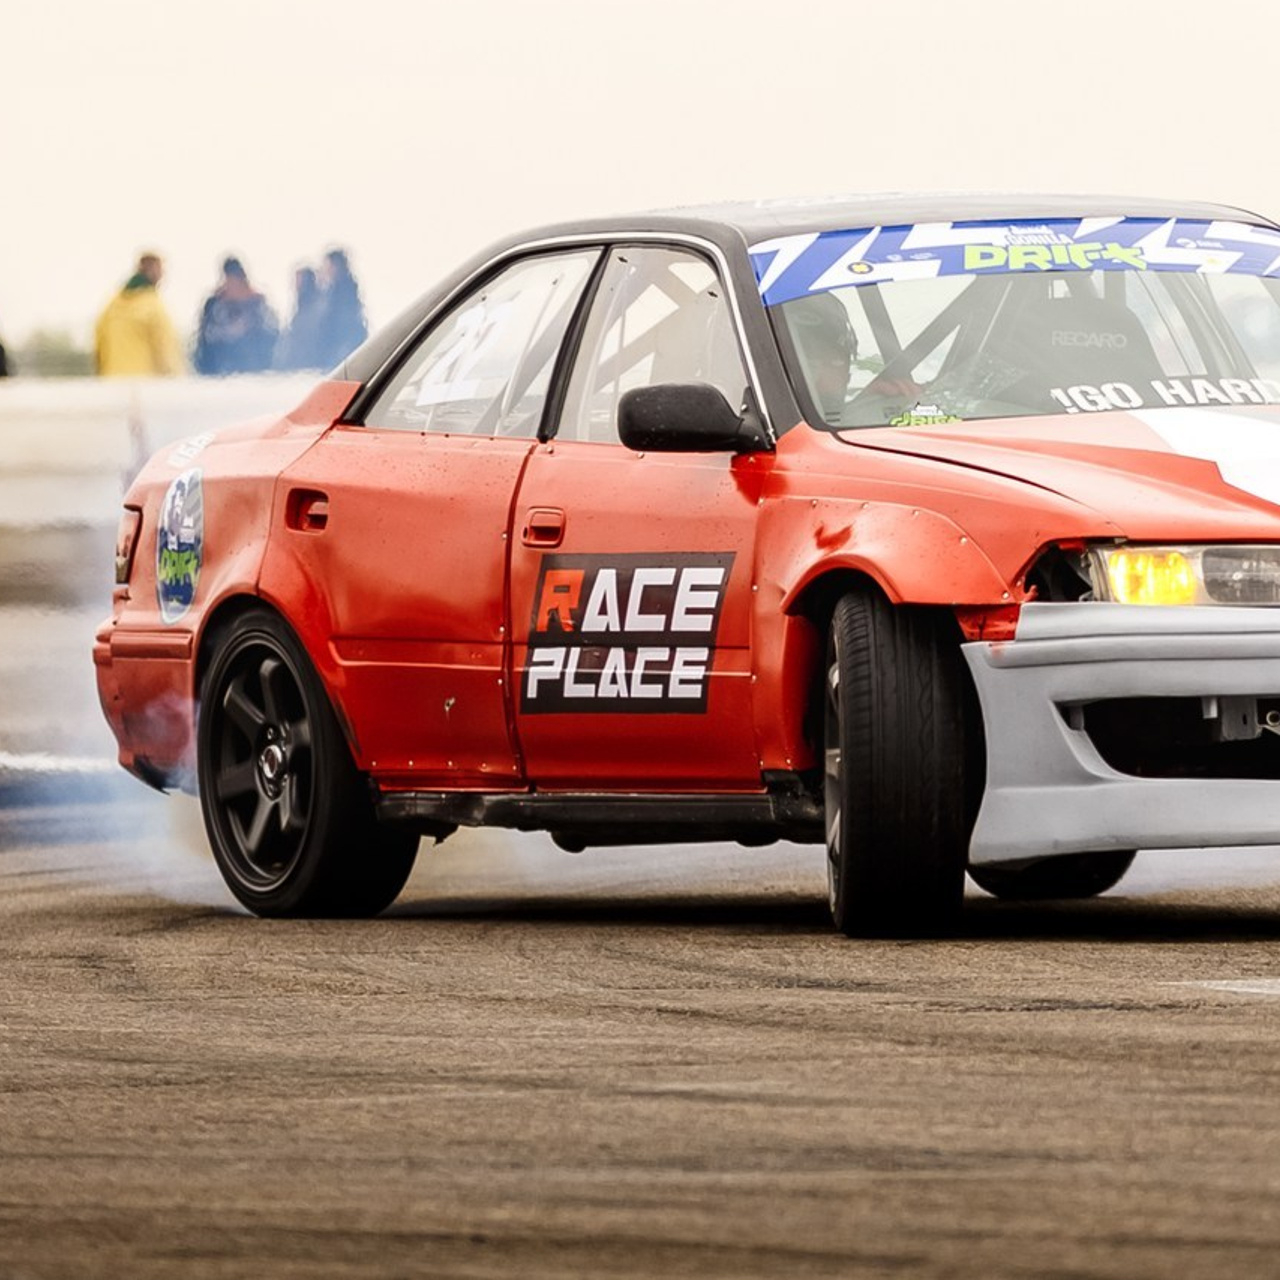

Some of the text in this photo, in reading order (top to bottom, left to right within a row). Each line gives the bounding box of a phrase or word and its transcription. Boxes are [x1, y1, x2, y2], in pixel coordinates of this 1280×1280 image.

[1051, 330, 1127, 348] RECARO
[536, 568, 725, 632] RACE
[527, 647, 709, 698] PLACE
